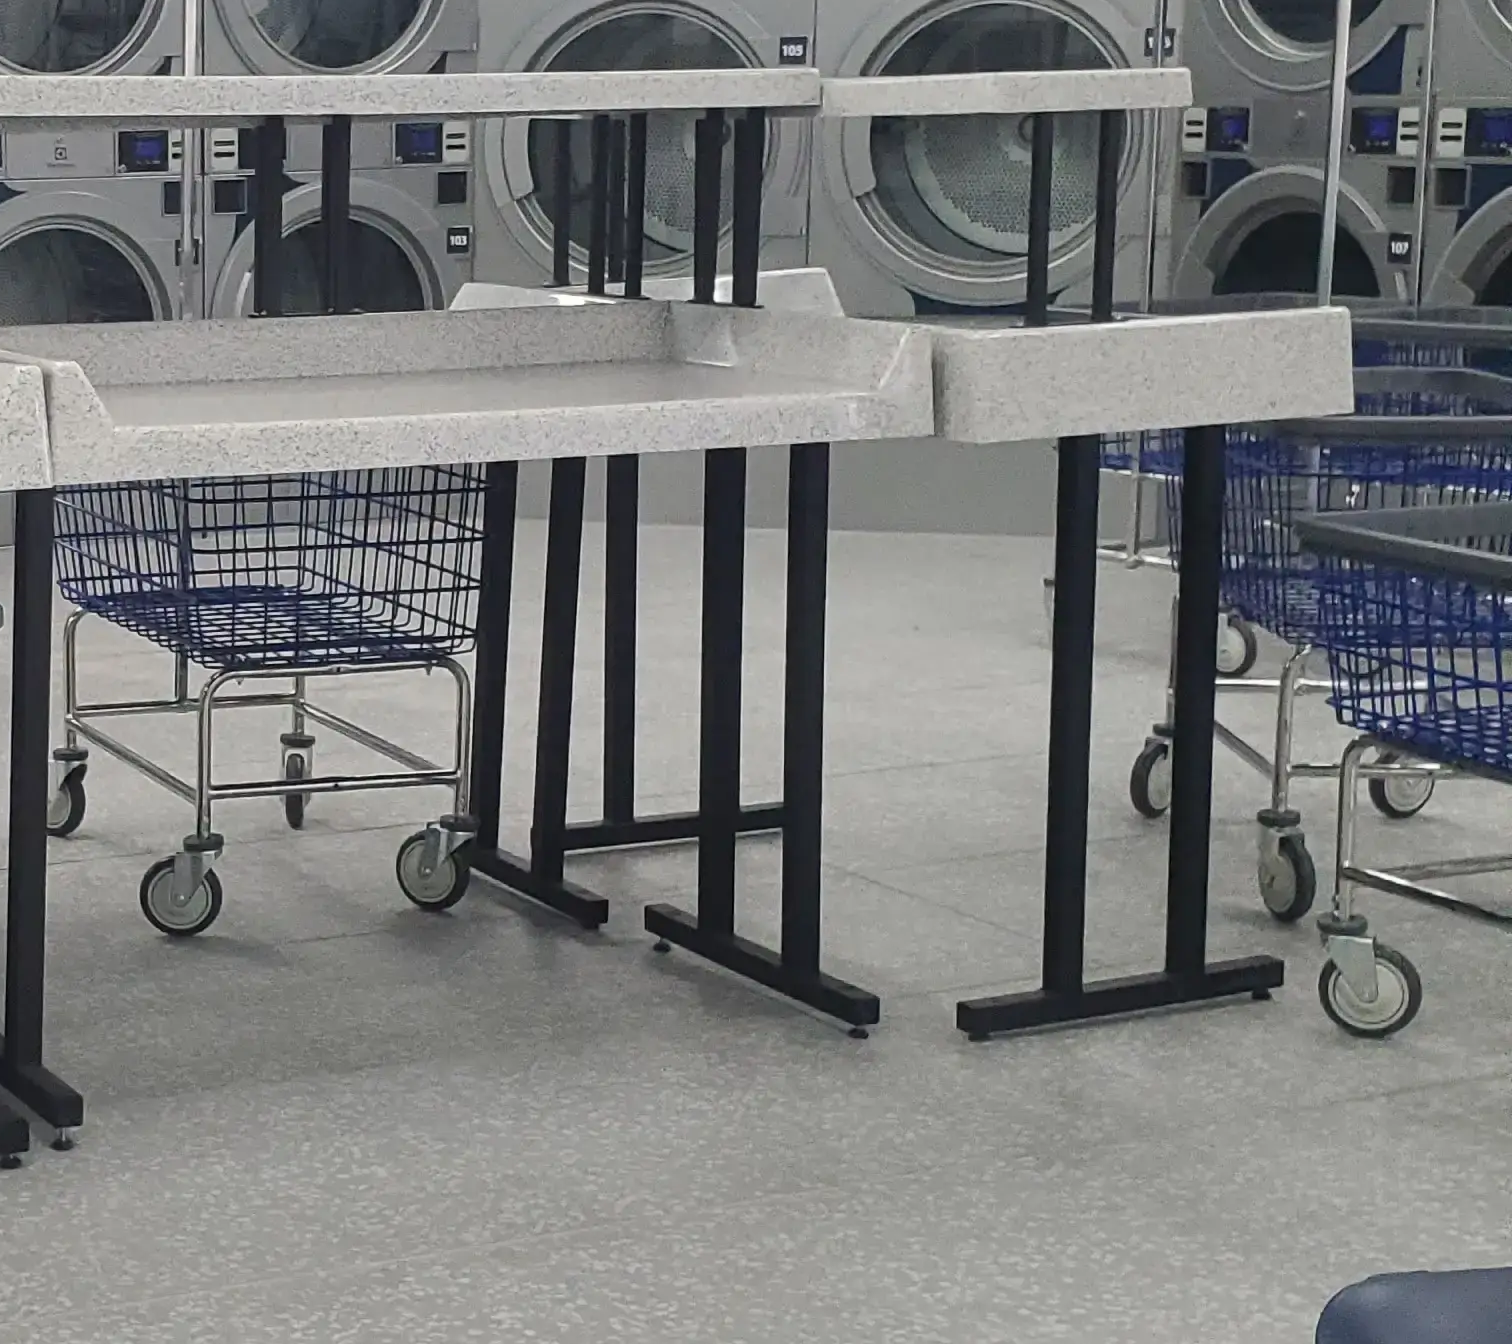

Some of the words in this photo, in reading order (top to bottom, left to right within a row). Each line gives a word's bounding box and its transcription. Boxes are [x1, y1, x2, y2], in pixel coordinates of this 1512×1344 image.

[782, 44, 804, 57] 105
[449, 235, 468, 246] 103
[1391, 240, 1409, 255] 107
